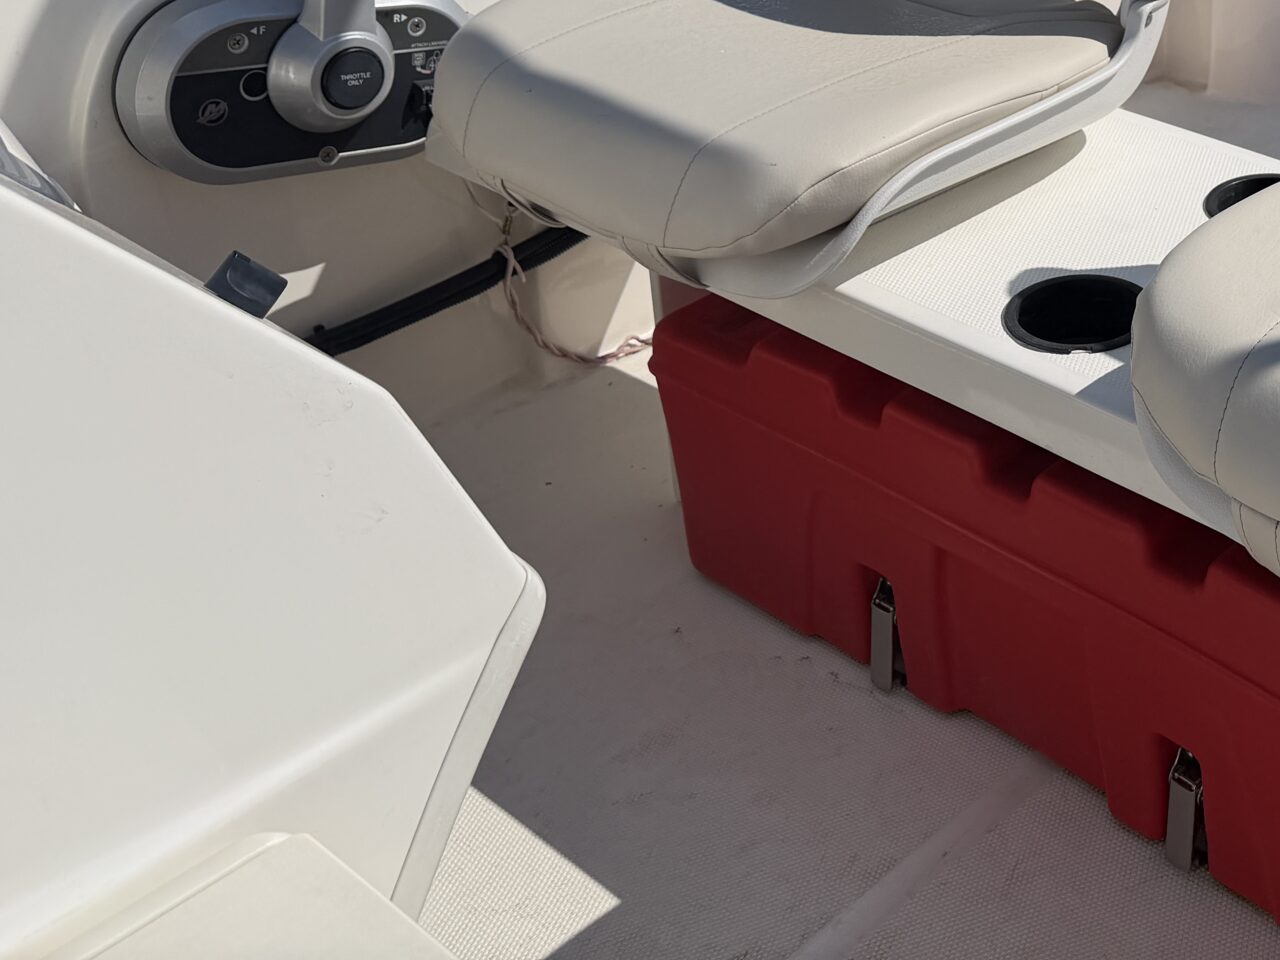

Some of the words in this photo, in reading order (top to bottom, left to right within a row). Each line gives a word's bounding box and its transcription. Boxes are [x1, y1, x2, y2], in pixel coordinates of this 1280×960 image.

[393, 13, 401, 23] R
[259, 25, 267, 36] F
[340, 71, 371, 81] THROTTLE
[347, 79, 364, 87] ONLY
